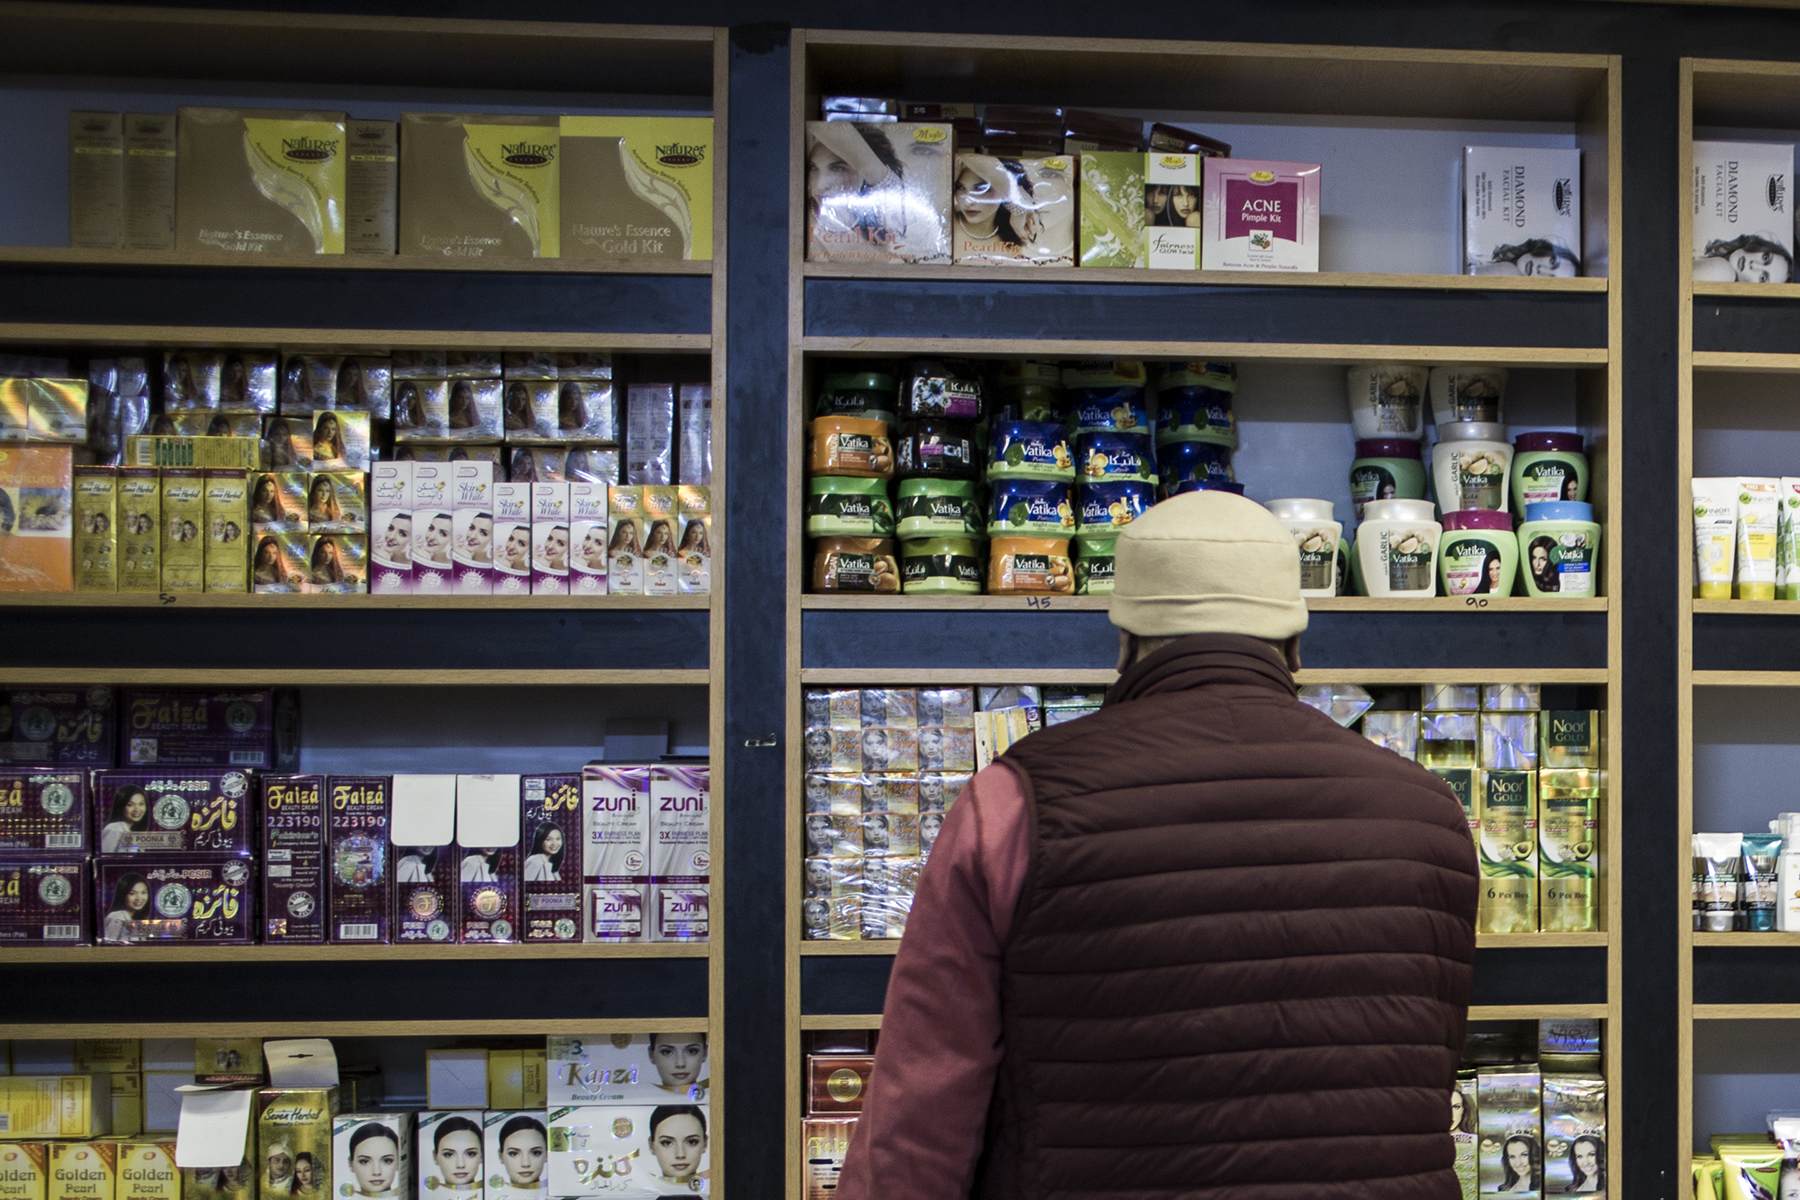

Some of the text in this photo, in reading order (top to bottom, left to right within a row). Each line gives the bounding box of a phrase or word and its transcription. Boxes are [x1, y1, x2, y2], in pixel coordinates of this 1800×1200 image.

[1502, 169, 1511, 223] FACIAL KIT
[1715, 164, 1723, 218] FACIAL KIT
[1728, 160, 1739, 224] DIAMOND
[1514, 166, 1526, 229] DIAMOND
[1242, 200, 1281, 212] ACNE
[1241, 213, 1281, 223] Pimple Kit
[572, 224, 671, 236] Nature's Essence
[602, 240, 664, 254] Gold Kit
[963, 241, 996, 252] Pearl
[1369, 372, 1378, 403] GARLIC
[839, 437, 869, 449] Vatika
[1021, 443, 1053, 457] Vatika
[1452, 451, 1460, 482] GARLIC
[1535, 467, 1565, 478] Vatika
[1356, 472, 1380, 482] Vatika
[1463, 475, 1488, 484] Vatika
[457, 482, 478, 494] Skin
[461, 491, 484, 501] White
[840, 503, 870, 516] Vatika
[930, 503, 961, 516] Vatika
[1025, 503, 1057, 516] Vatika
[1081, 504, 1108, 517] Vatika
[1381, 530, 1389, 561] GARLIC
[1456, 545, 1487, 557] Vatika
[1392, 554, 1419, 564] Vatika
[1558, 549, 1584, 559] Vatika
[839, 558, 870, 570] Vatika
[1015, 558, 1045, 570] Vatika
[1026, 595, 1052, 608] 45
[1553, 718, 1586, 734] Noor
[1555, 733, 1584, 743] GOLD
[181, 781, 210, 791] PCSIR
[1491, 778, 1523, 793] Noor
[268, 785, 319, 810] Faiza
[333, 785, 384, 810] Faiza
[593, 788, 636, 812] zuni
[660, 788, 704, 812] zuni
[1493, 792, 1522, 802] GOLD
[268, 816, 320, 827] 223190
[333, 816, 385, 827] 223190
[136, 835, 164, 843] POONIA
[592, 831, 603, 839] 3X
[659, 831, 670, 839] 3X
[182, 870, 212, 879] PCSIR
[1487, 887, 1496, 899] 6
[1548, 887, 1556, 899] 6
[604, 902, 633, 913] zuni
[671, 902, 700, 913] zuni
[571, 1040, 583, 1055] 3
[558, 1062, 639, 1093] Kanza
[572, 1093, 597, 1102] Beauty
[264, 1107, 322, 1121] Seven Herbal
[55, 1168, 106, 1181] Golden
[123, 1168, 174, 1181] Golden
[65, 1183, 97, 1194] Pearl
[133, 1183, 164, 1194] Pearl
